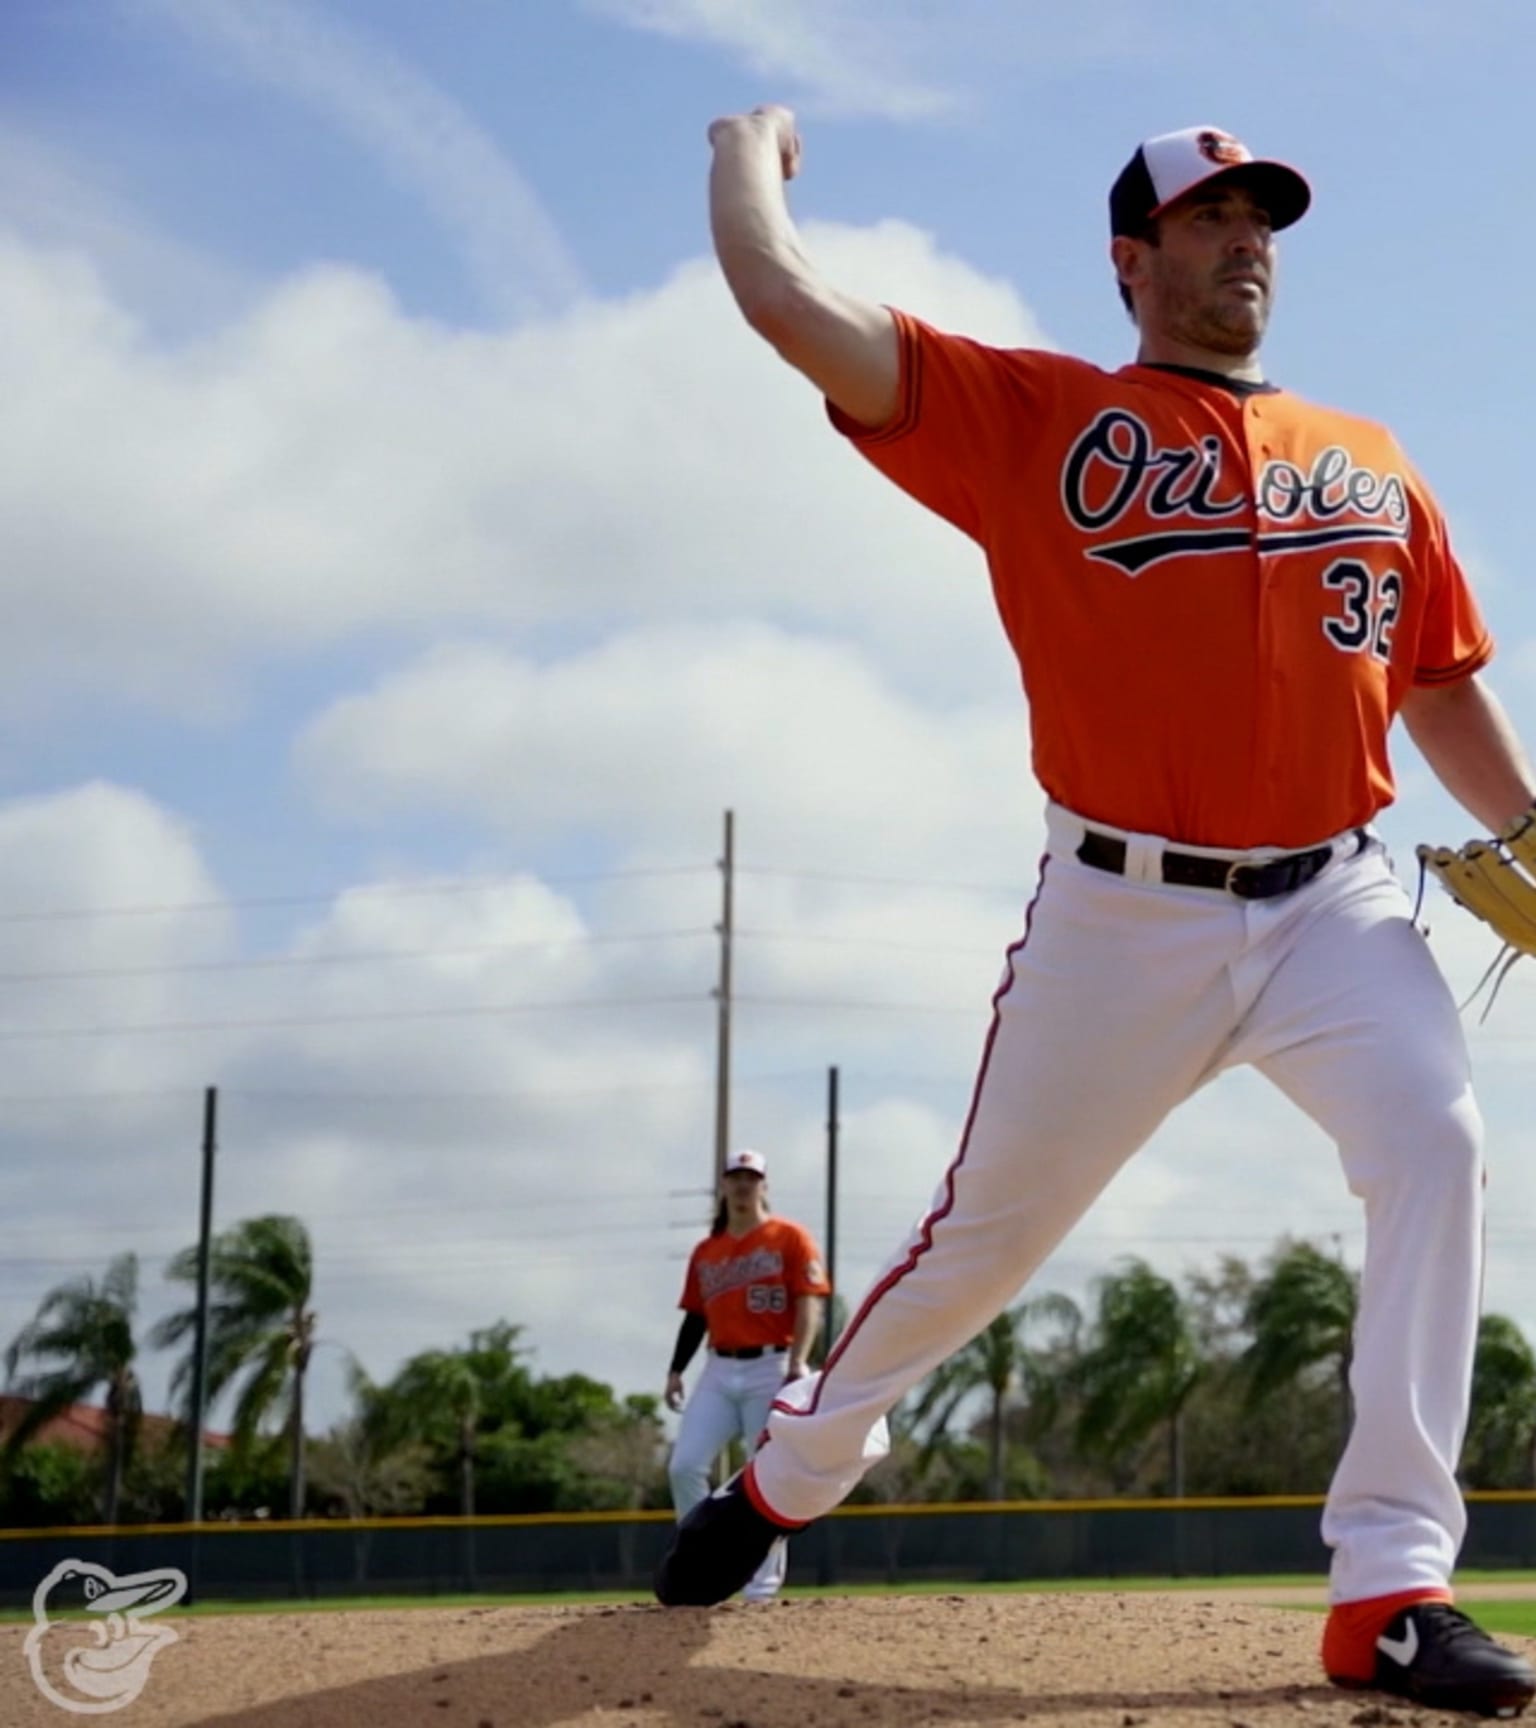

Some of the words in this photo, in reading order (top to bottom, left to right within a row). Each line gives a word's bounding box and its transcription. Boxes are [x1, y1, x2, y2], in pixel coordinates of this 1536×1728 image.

[1061, 408, 1408, 532] Orioles
[1322, 557, 1402, 665] 32
[747, 1284, 787, 1313] 56
